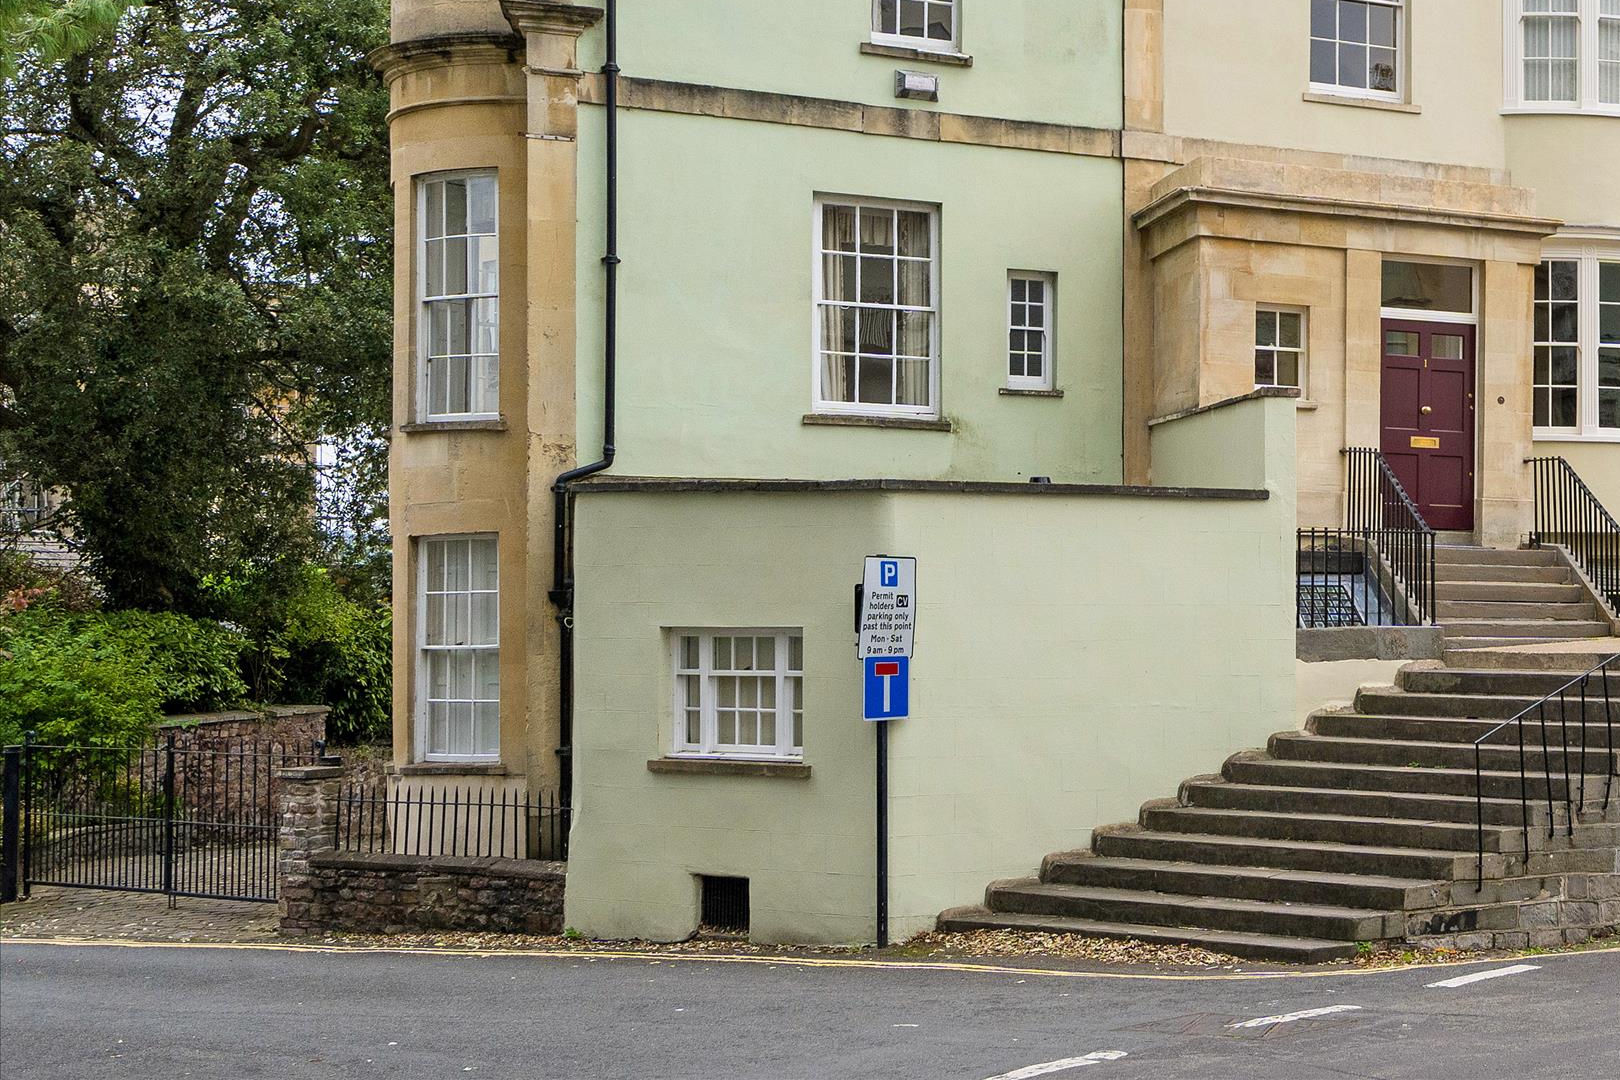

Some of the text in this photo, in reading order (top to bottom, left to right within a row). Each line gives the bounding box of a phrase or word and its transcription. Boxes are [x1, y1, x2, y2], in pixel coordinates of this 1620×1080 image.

[885, 564, 896, 584] P
[897, 596, 908, 606] CV
[867, 612, 909, 621] parking only
[894, 622, 912, 631] point
